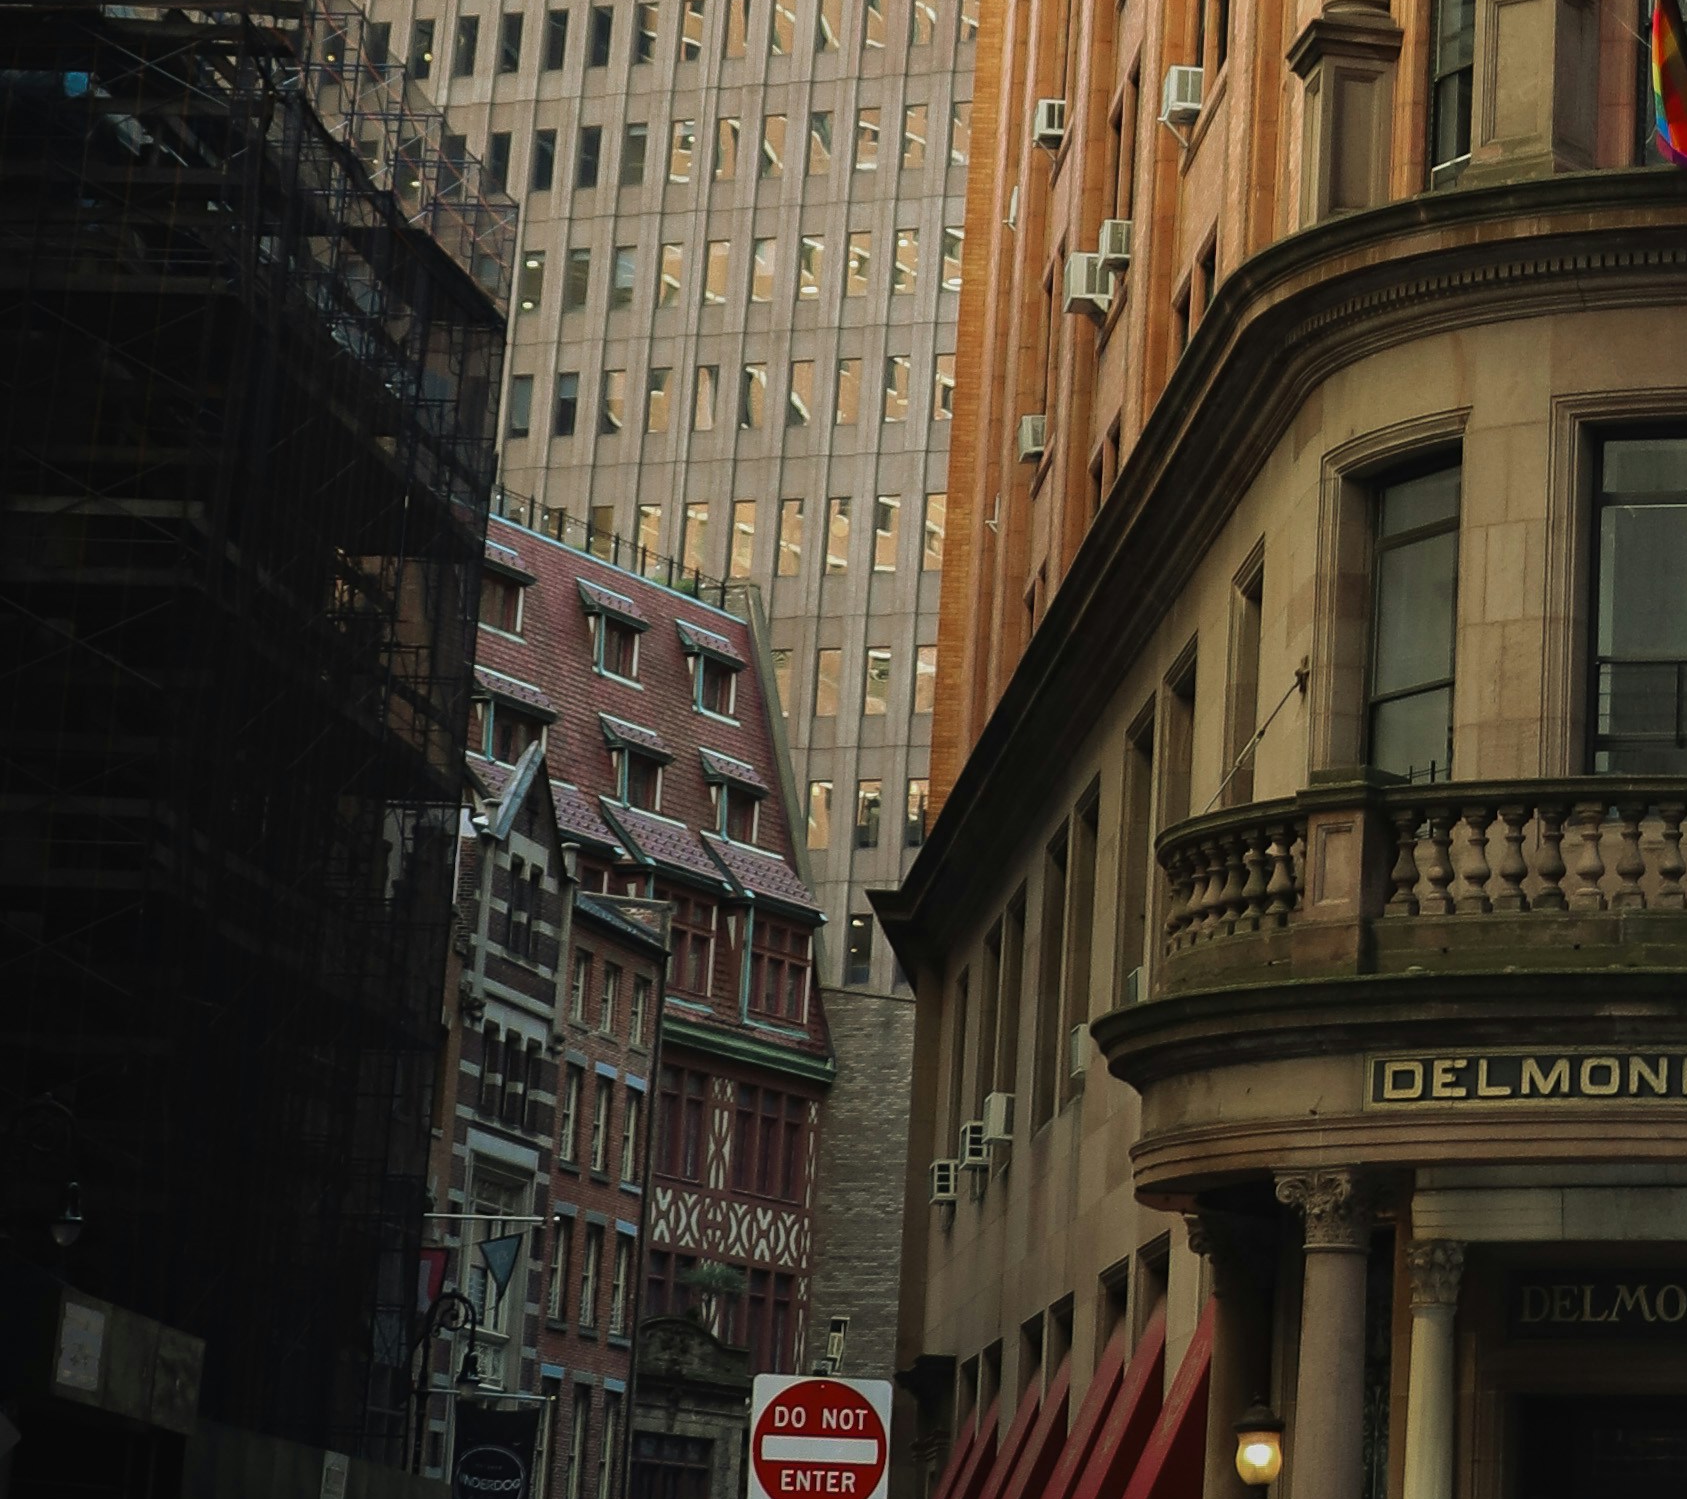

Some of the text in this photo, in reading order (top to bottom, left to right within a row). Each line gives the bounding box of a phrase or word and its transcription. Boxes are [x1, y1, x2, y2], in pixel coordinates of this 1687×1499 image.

[774, 1405, 868, 1431] DO NOT
[780, 1469, 856, 1493] ENTER
